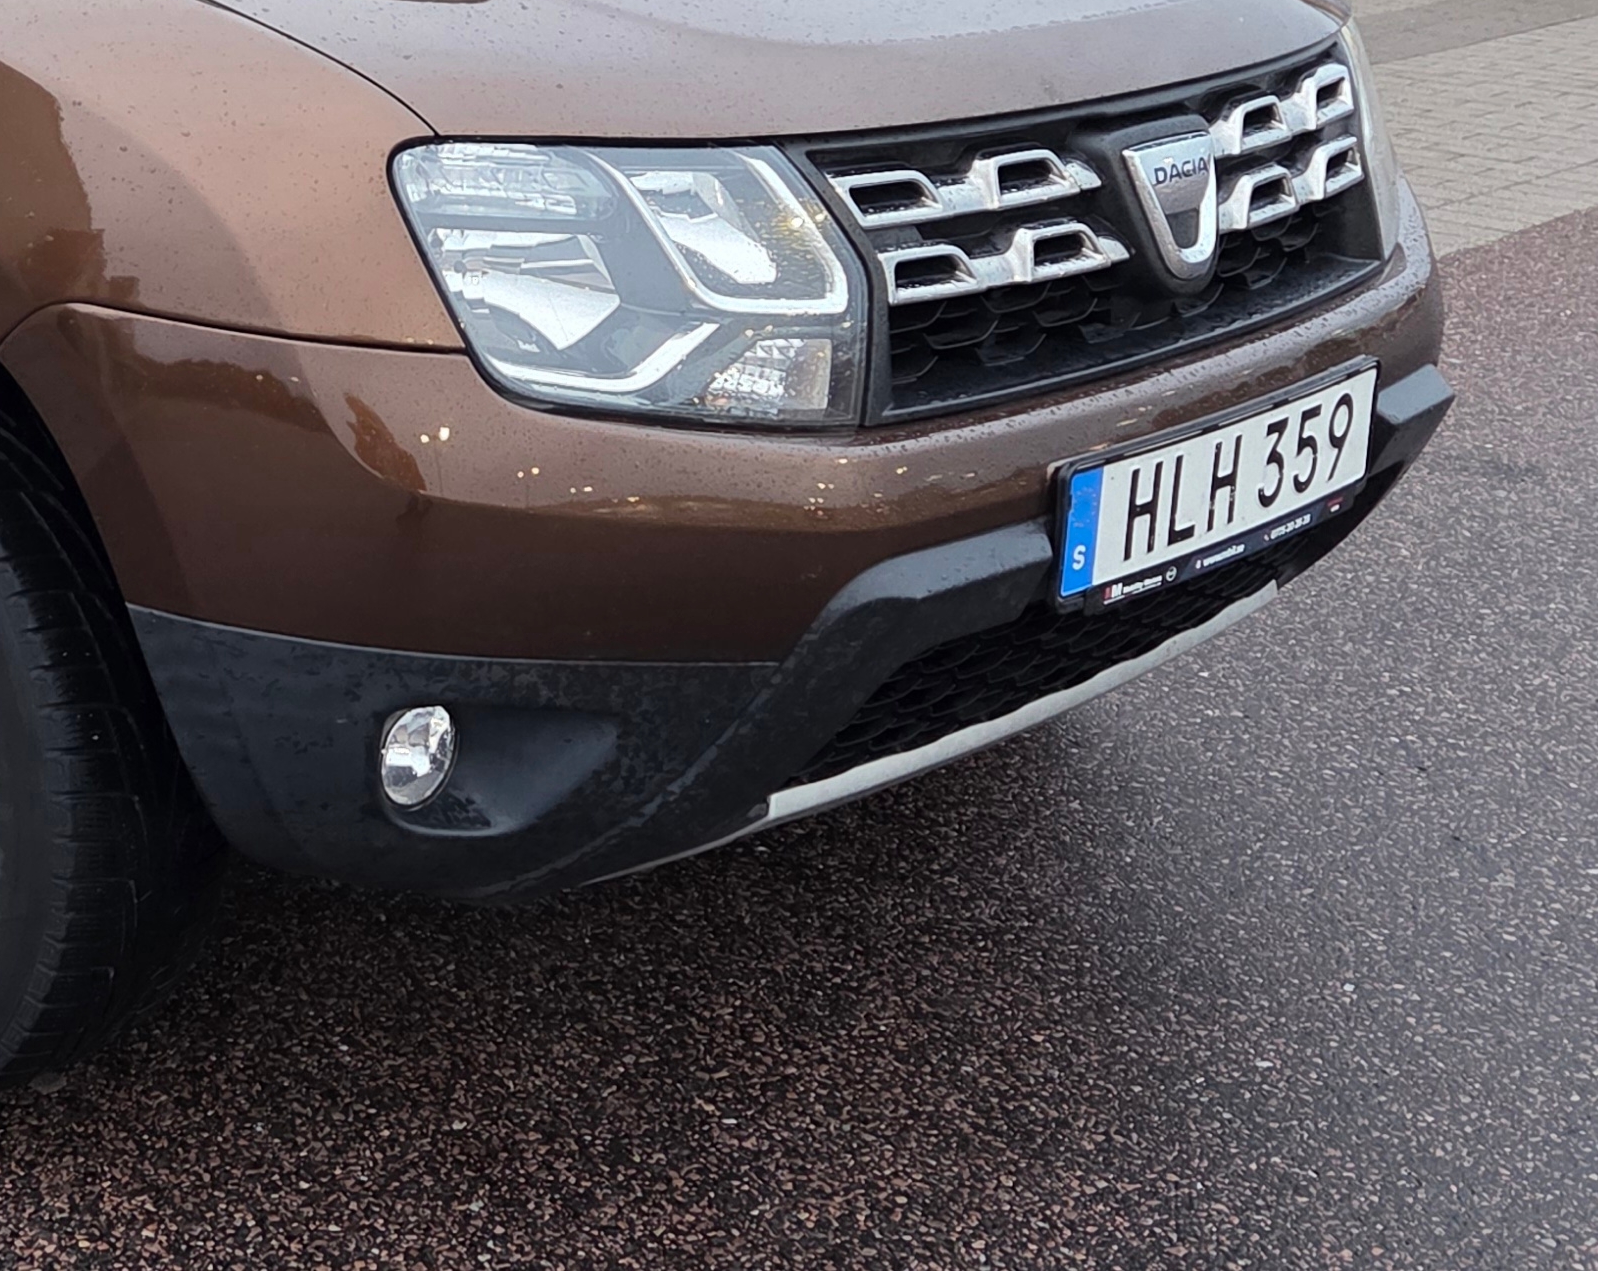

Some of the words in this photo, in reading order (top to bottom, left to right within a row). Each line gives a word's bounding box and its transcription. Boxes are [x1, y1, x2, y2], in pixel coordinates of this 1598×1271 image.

[1153, 156, 1209, 185] DACIA
[1122, 434, 1243, 562] HLH
[1258, 392, 1354, 508] 359
[1072, 544, 1086, 571] S
